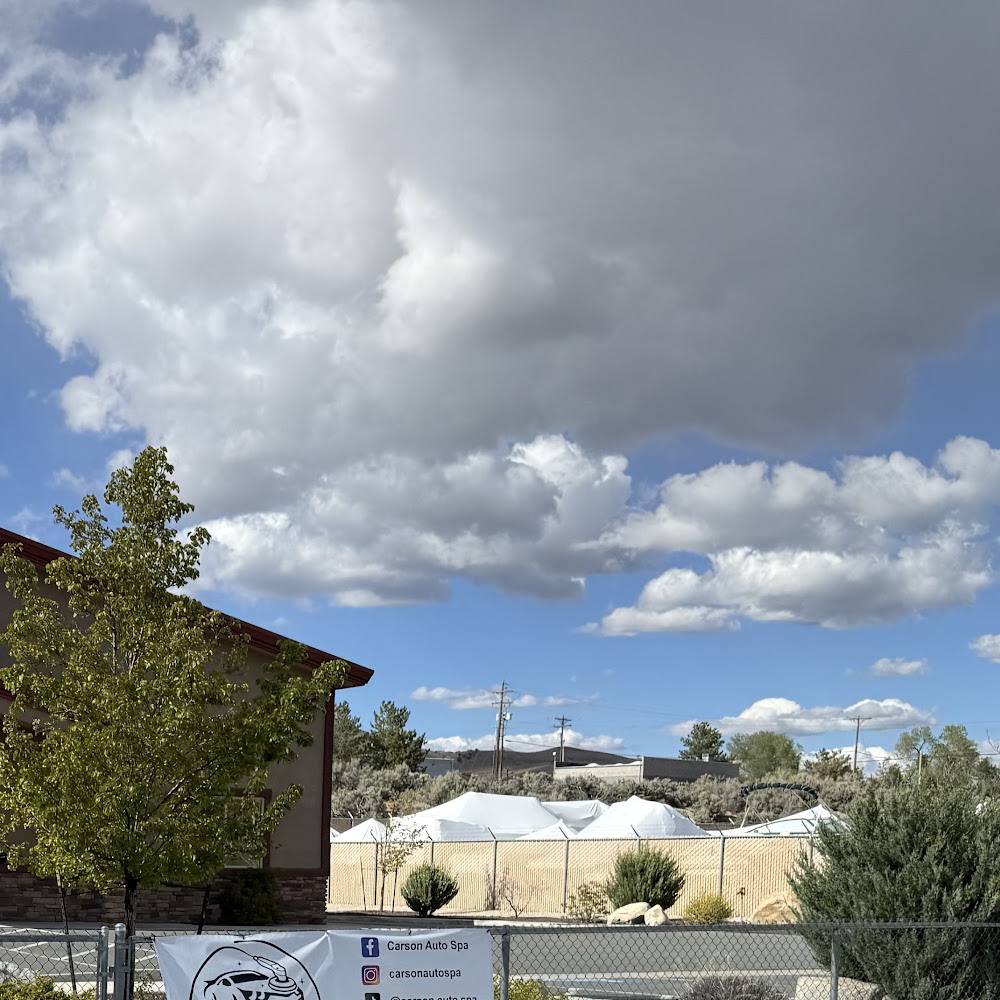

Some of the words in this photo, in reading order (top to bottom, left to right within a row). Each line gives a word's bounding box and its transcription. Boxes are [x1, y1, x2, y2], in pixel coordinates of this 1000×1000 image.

[387, 941, 423, 951] Carson
[425, 940, 448, 951] Auto
[450, 940, 469, 952] Spa
[389, 968, 462, 980] carsonautospa
